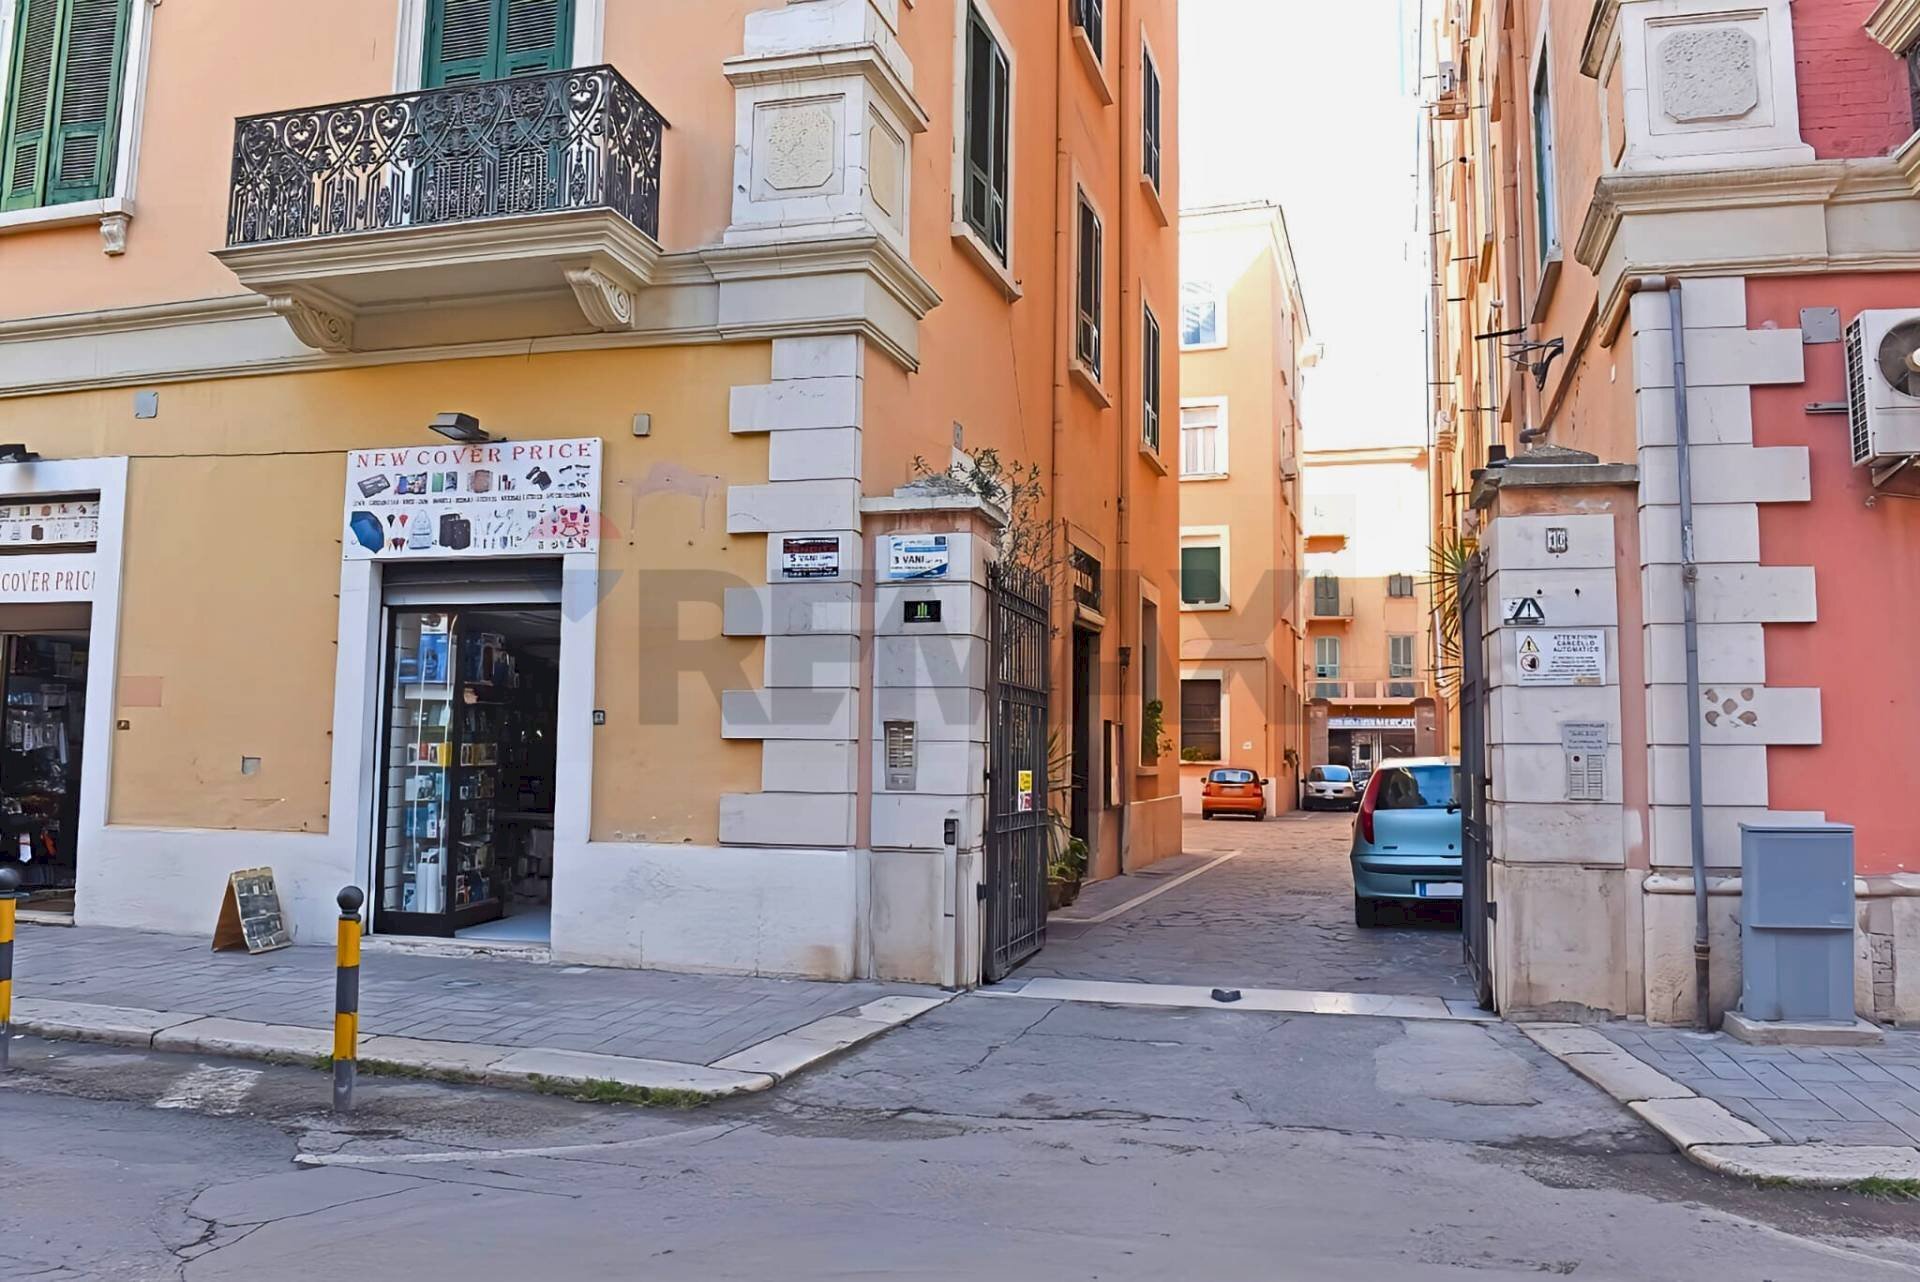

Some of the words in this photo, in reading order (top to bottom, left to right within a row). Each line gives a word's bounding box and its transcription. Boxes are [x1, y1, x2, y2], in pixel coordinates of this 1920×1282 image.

[356, 451, 408, 468] NEW
[417, 446, 500, 465] COVER
[512, 443, 592, 460] PRICE
[902, 555, 925, 563] VANI
[1, 570, 50, 592] COVER
